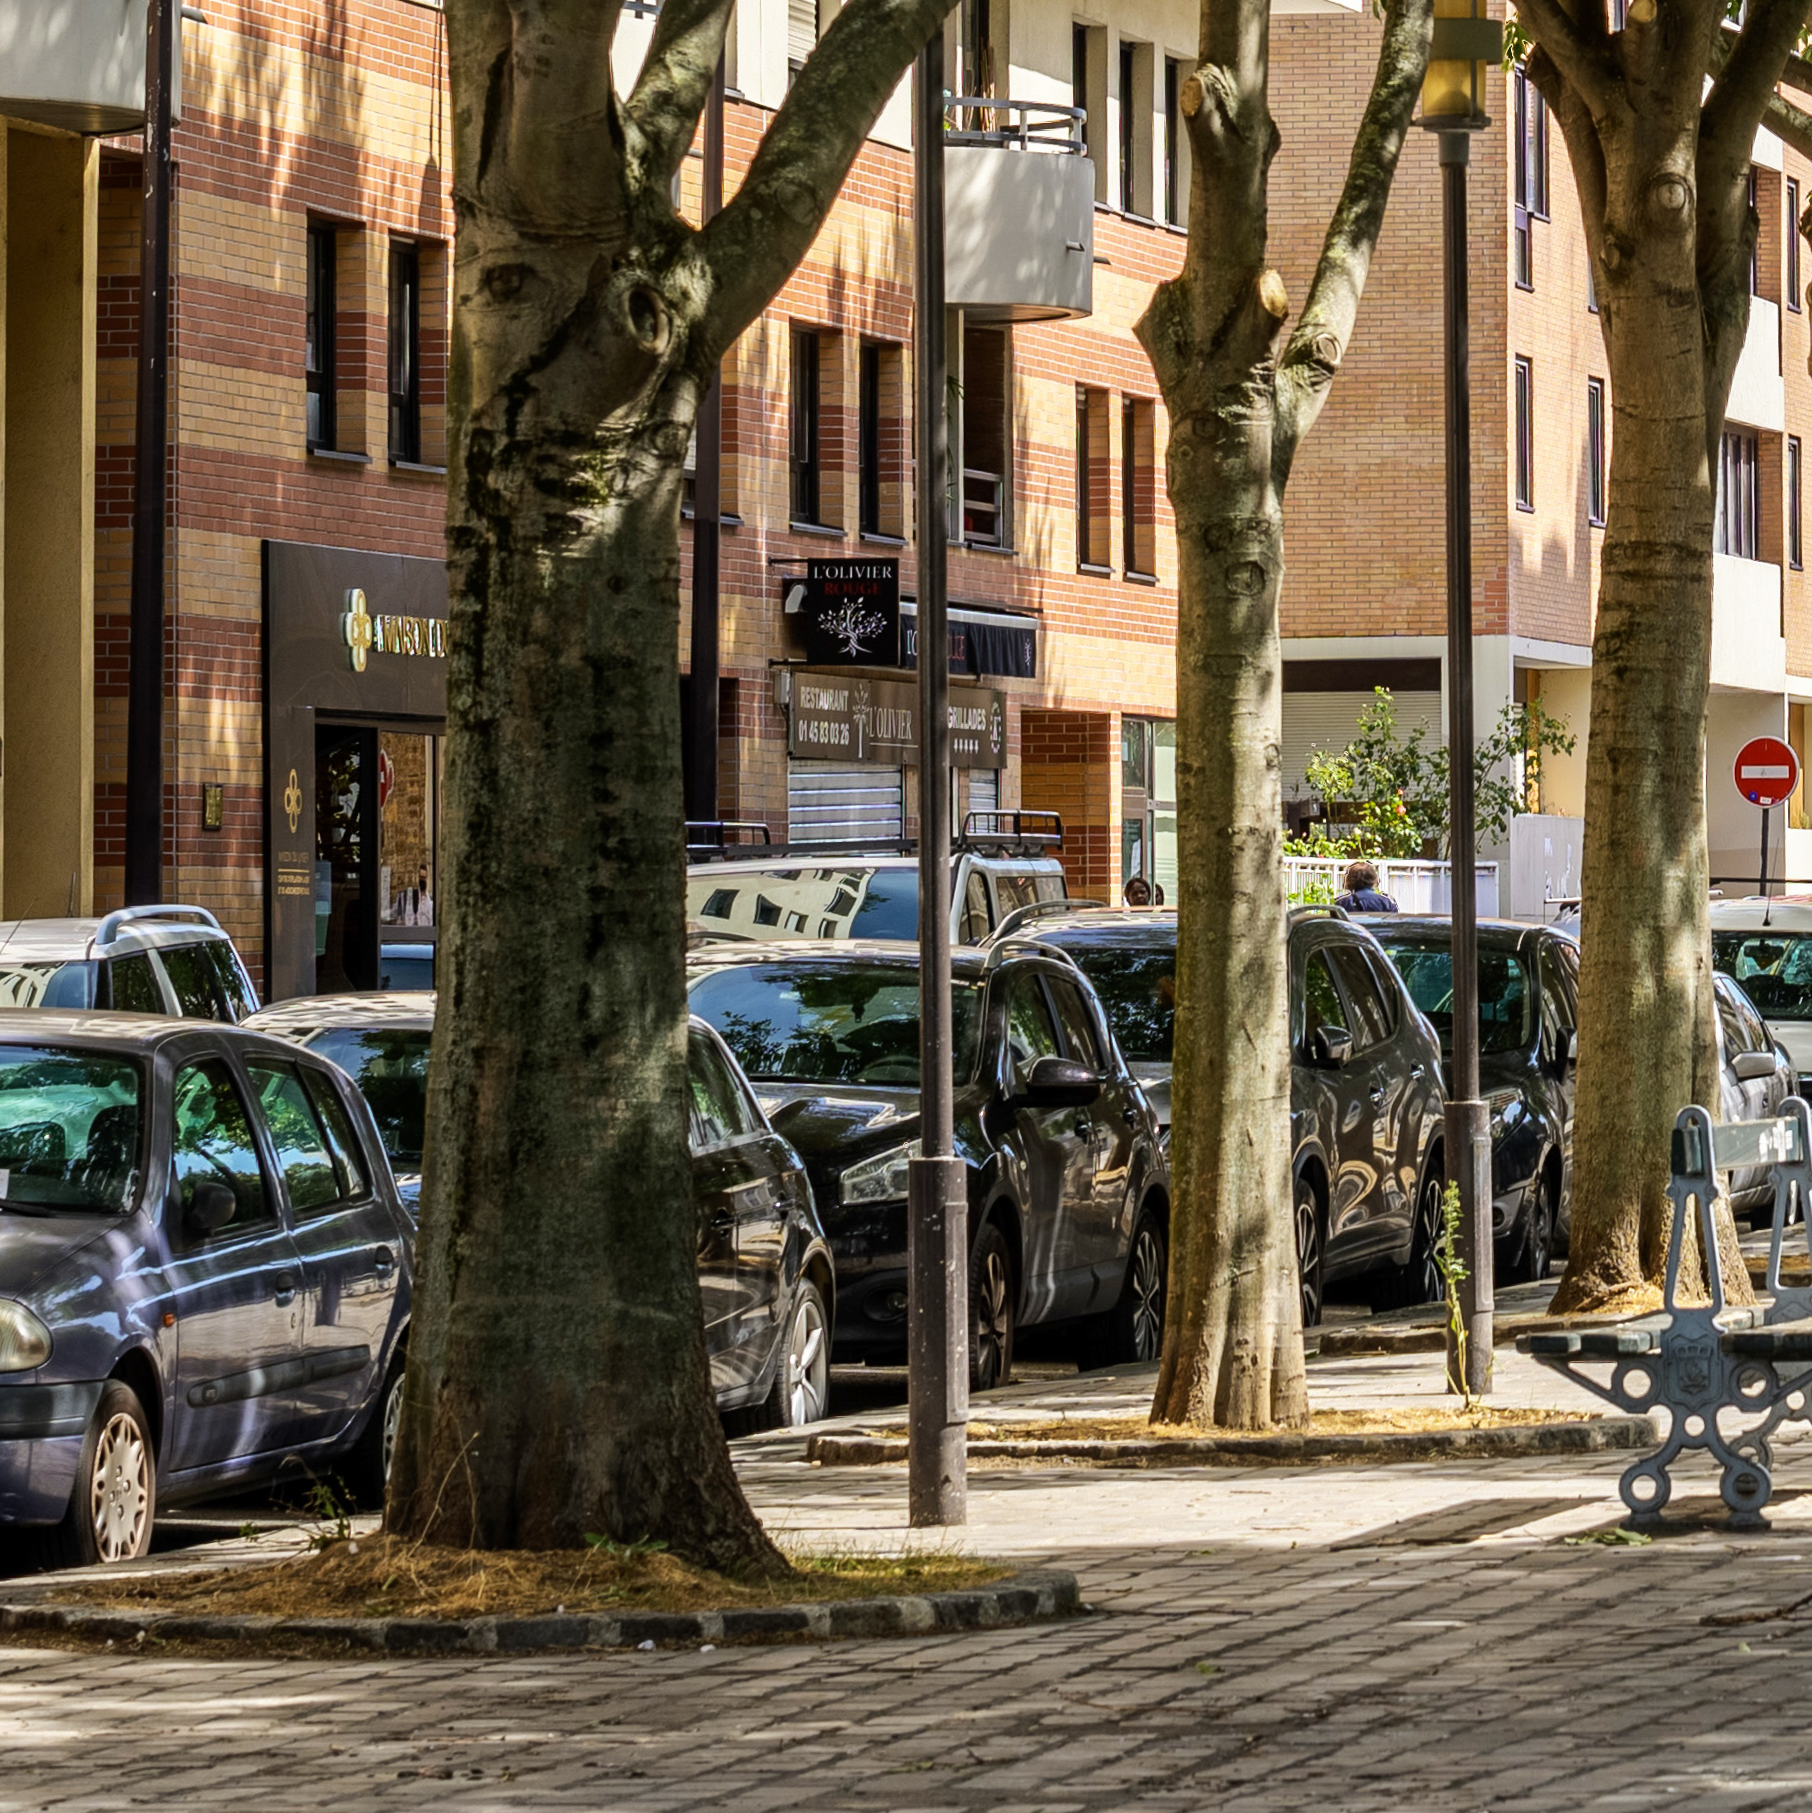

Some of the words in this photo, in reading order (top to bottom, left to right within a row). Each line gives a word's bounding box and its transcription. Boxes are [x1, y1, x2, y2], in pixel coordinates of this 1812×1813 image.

[813, 565, 893, 579] L'OLIVIER
[824, 581, 881, 595] ROUGE
[800, 685, 849, 712] RESTAURANT
[869, 706, 913, 740] L'OLIVIER
[947, 706, 987, 731] GRILLADES
[798, 719, 808, 742] 01
[808, 720, 819, 743] 45
[819, 721, 829, 744] 83
[829, 722, 840, 745] 03
[840, 722, 850, 746] 26
